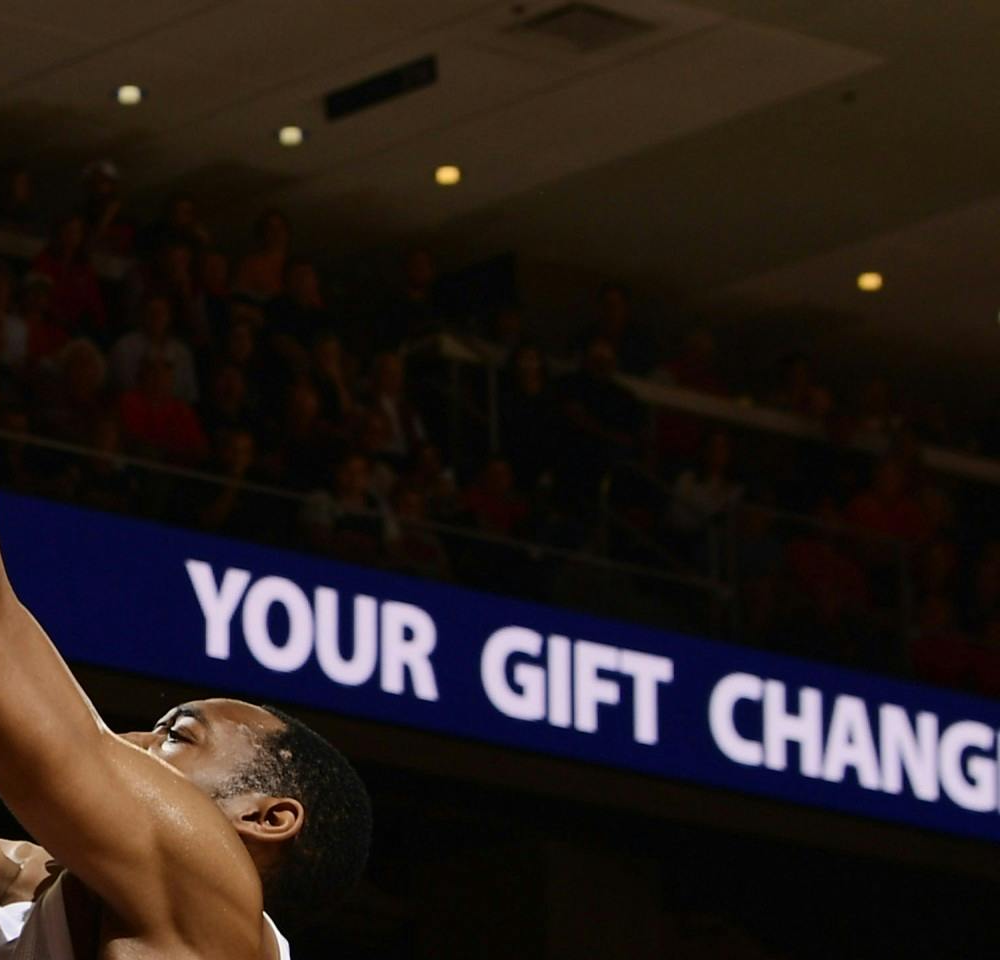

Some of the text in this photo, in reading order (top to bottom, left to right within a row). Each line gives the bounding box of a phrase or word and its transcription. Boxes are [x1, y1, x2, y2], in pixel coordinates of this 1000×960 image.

[185, 558, 1000, 814] YOUR GIFT CHANG
